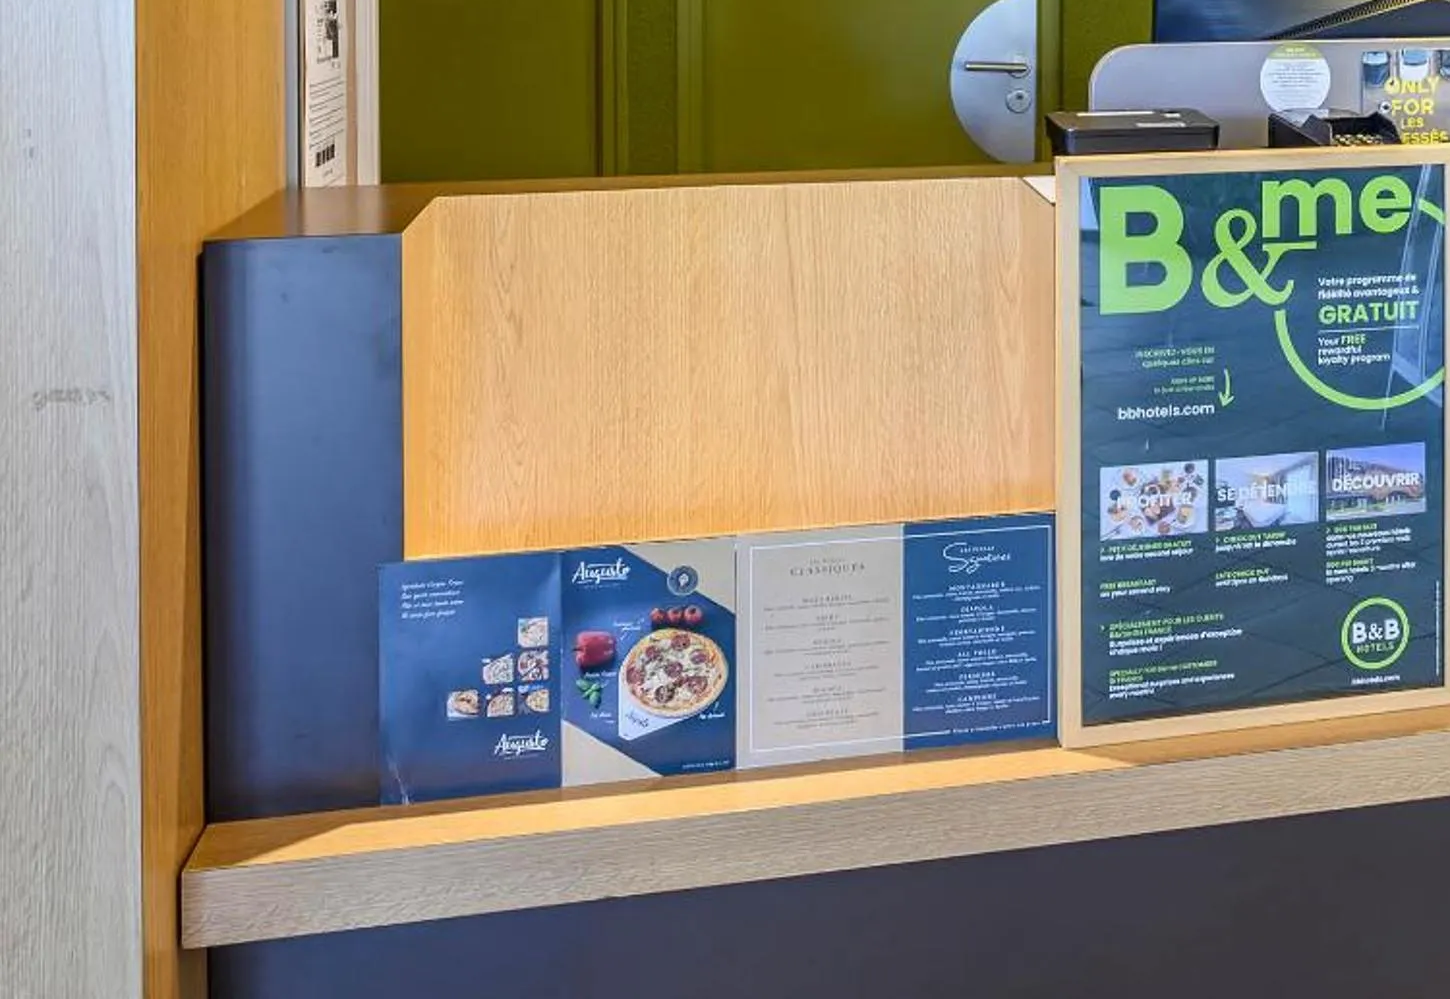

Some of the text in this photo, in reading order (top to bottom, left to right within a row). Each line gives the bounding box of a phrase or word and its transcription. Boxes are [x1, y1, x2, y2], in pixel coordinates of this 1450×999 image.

[1384, 75, 1440, 95] ONLY
[1391, 98, 1435, 117] FOR
[1318, 272, 1417, 287] Votre programme de
[1318, 285, 1420, 300] fidélité avantageux &
[1318, 300, 1420, 325] GRATUIT
[1318, 333, 1366, 347] Your FREE
[1318, 353, 1391, 366] loyalty program
[1117, 403, 1215, 421] bbhotels.com
[1331, 471, 1421, 493] DÉCOUVRIR
[571, 557, 631, 585] Augusto
[1352, 618, 1400, 644] B&B
[1356, 641, 1395, 654] HOTELS
[494, 728, 550, 756] Augusto
